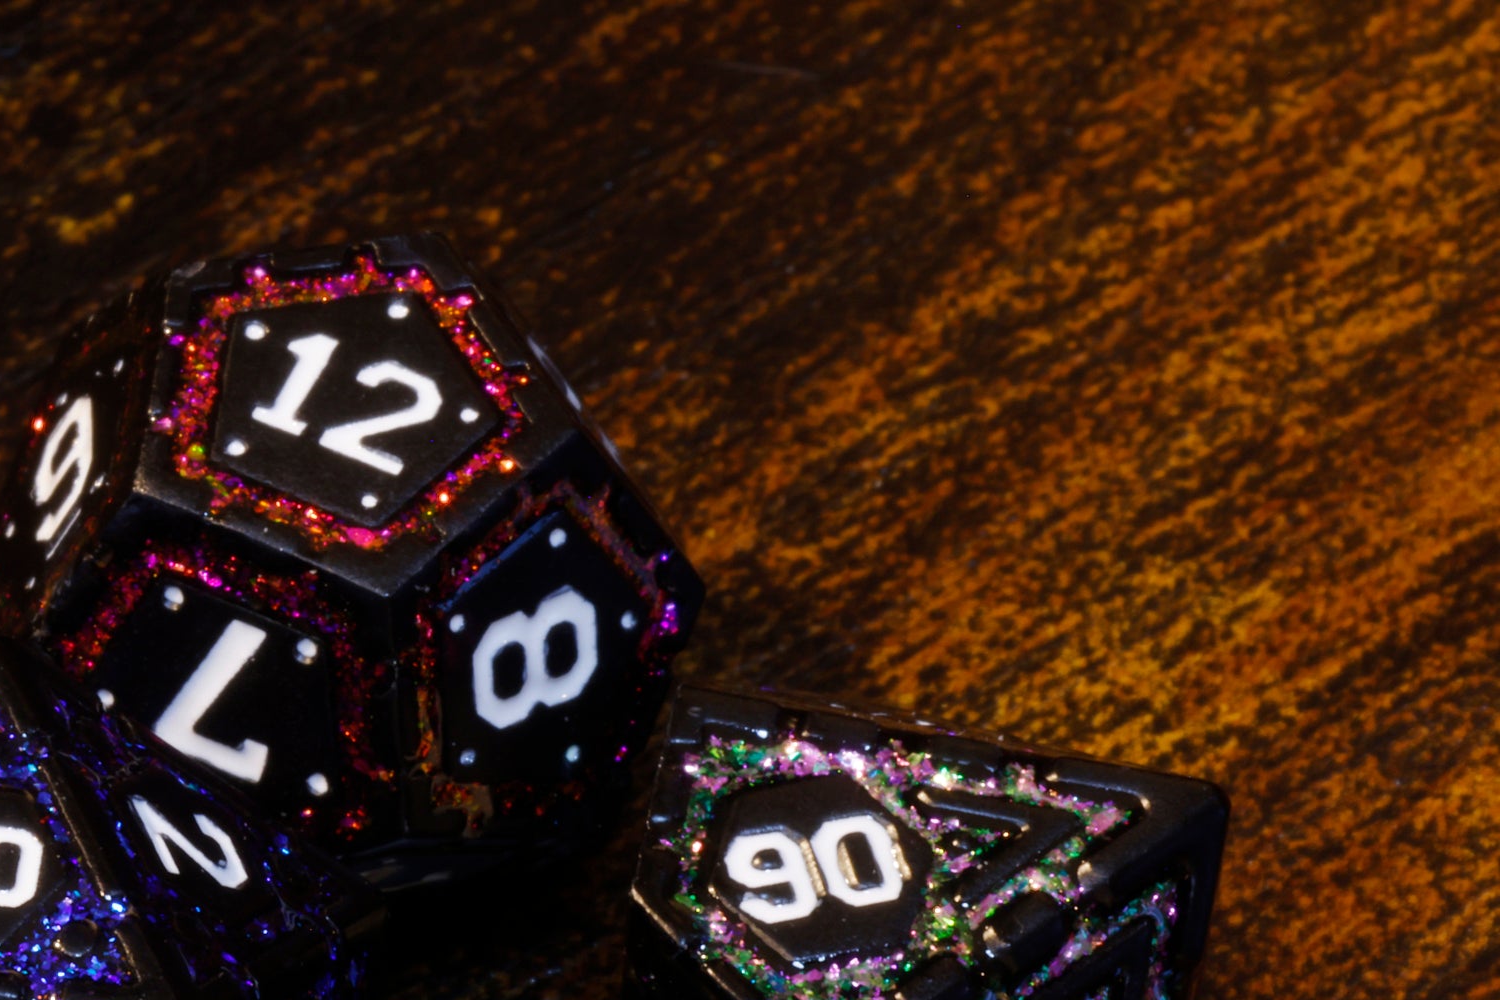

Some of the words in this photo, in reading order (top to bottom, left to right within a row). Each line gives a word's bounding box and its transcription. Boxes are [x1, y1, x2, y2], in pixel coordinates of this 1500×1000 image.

[251, 332, 443, 476] 12
[155, 620, 268, 781] 7
[474, 592, 596, 728] 8
[133, 800, 248, 888] 2
[723, 811, 905, 924] 90
